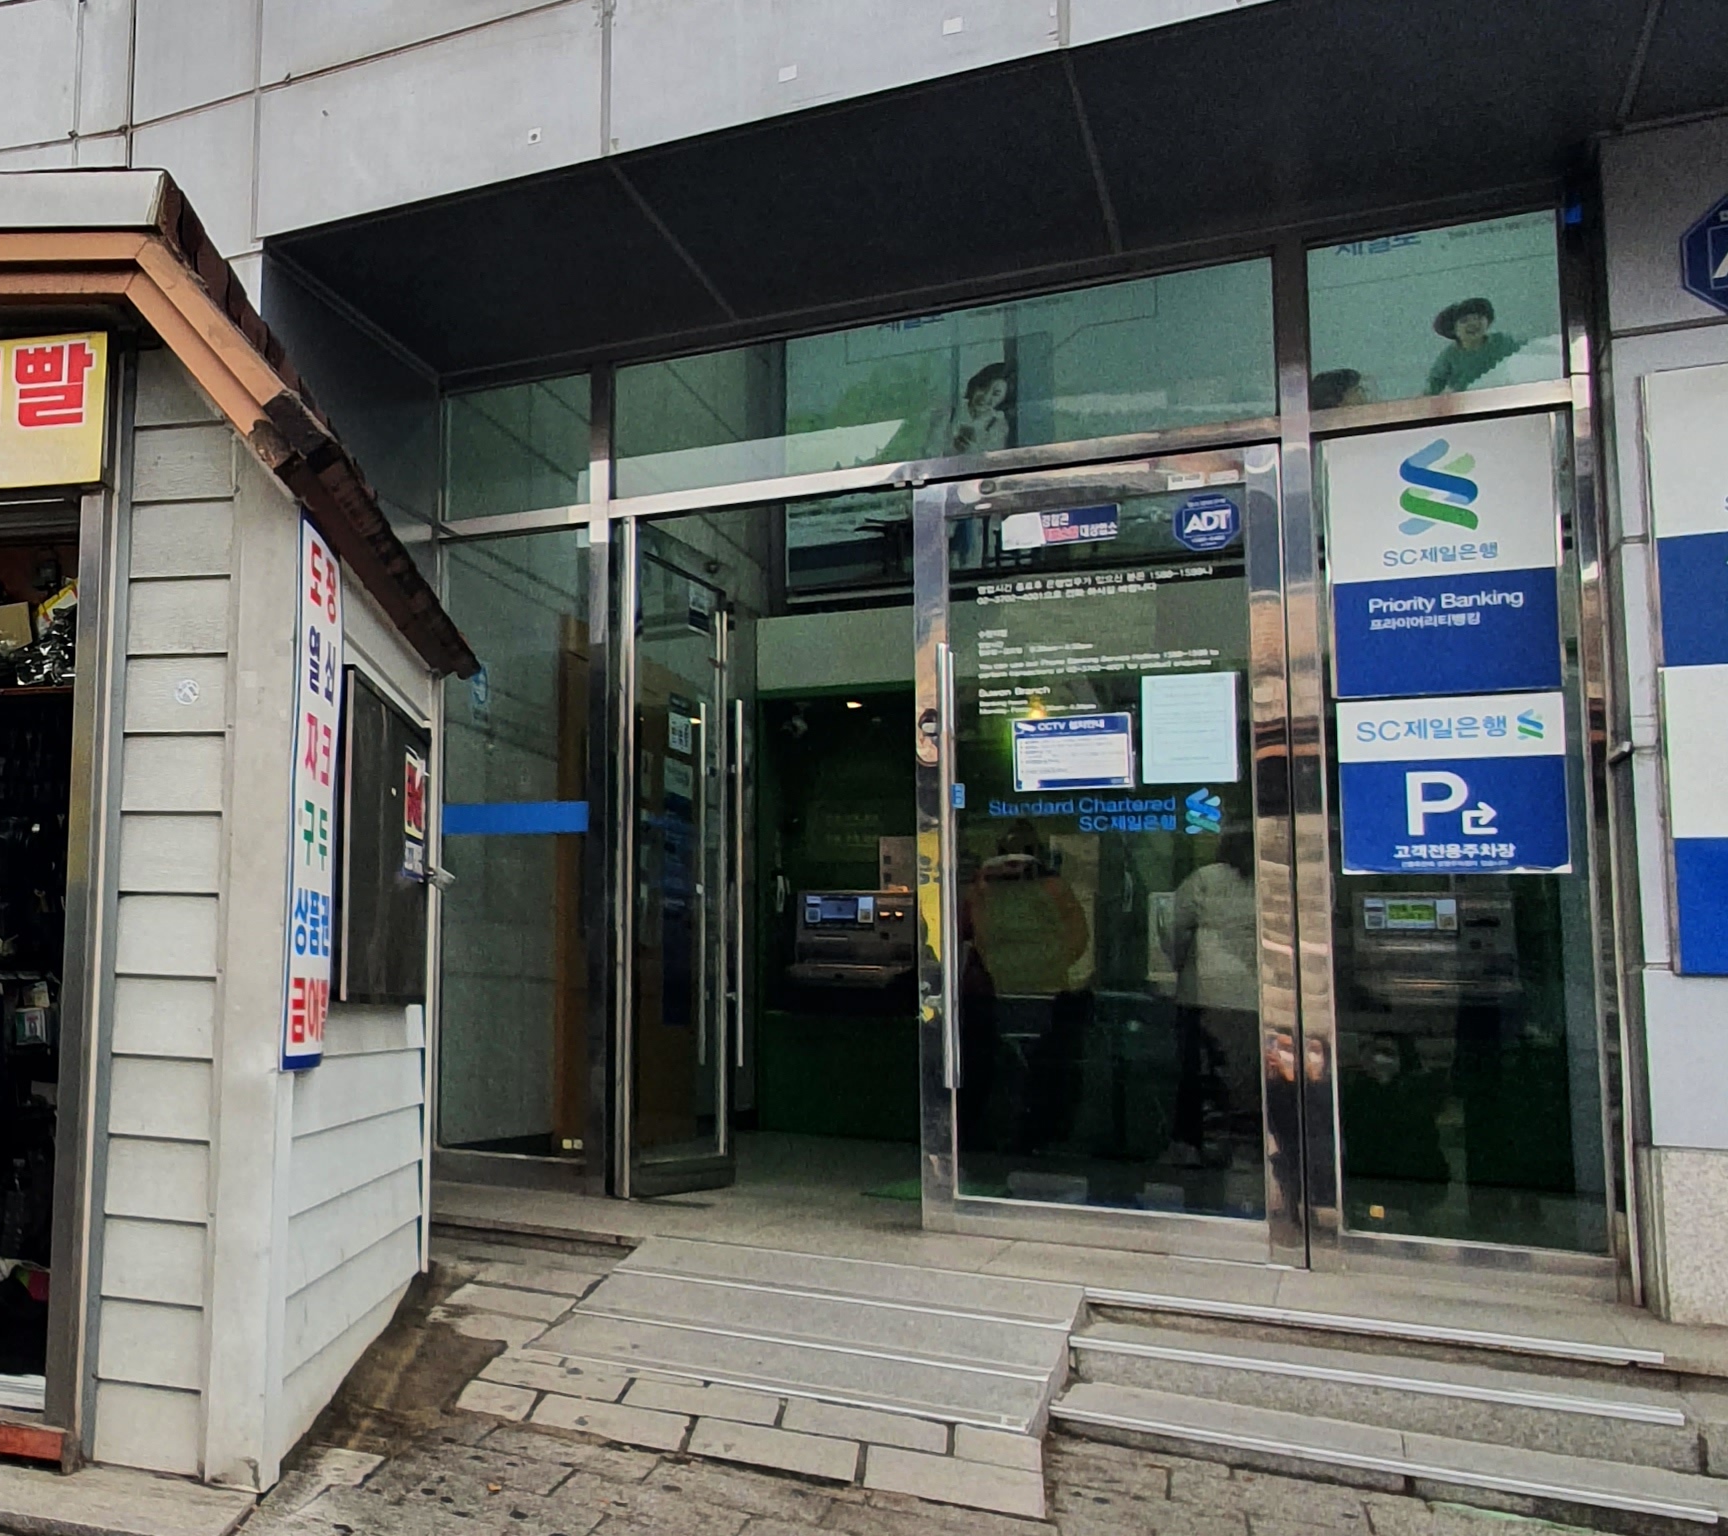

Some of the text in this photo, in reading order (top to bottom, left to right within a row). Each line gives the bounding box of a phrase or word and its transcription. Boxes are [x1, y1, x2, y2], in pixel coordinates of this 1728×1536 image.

[1184, 509, 1232, 533] ADT
[1383, 541, 1498, 567] SC제일은행
[310, 540, 337, 624] 도장
[1368, 590, 1524, 613] Priority Banking
[1037, 720, 1066, 732] CCTV
[1356, 714, 1508, 743] SC제일은행
[305, 712, 332, 786] 자크
[988, 796, 1176, 816] Standard Chartered
[1405, 770, 1469, 836] P
[303, 799, 328, 871] 구두
[1393, 842, 1517, 859] 고객전용주차장
